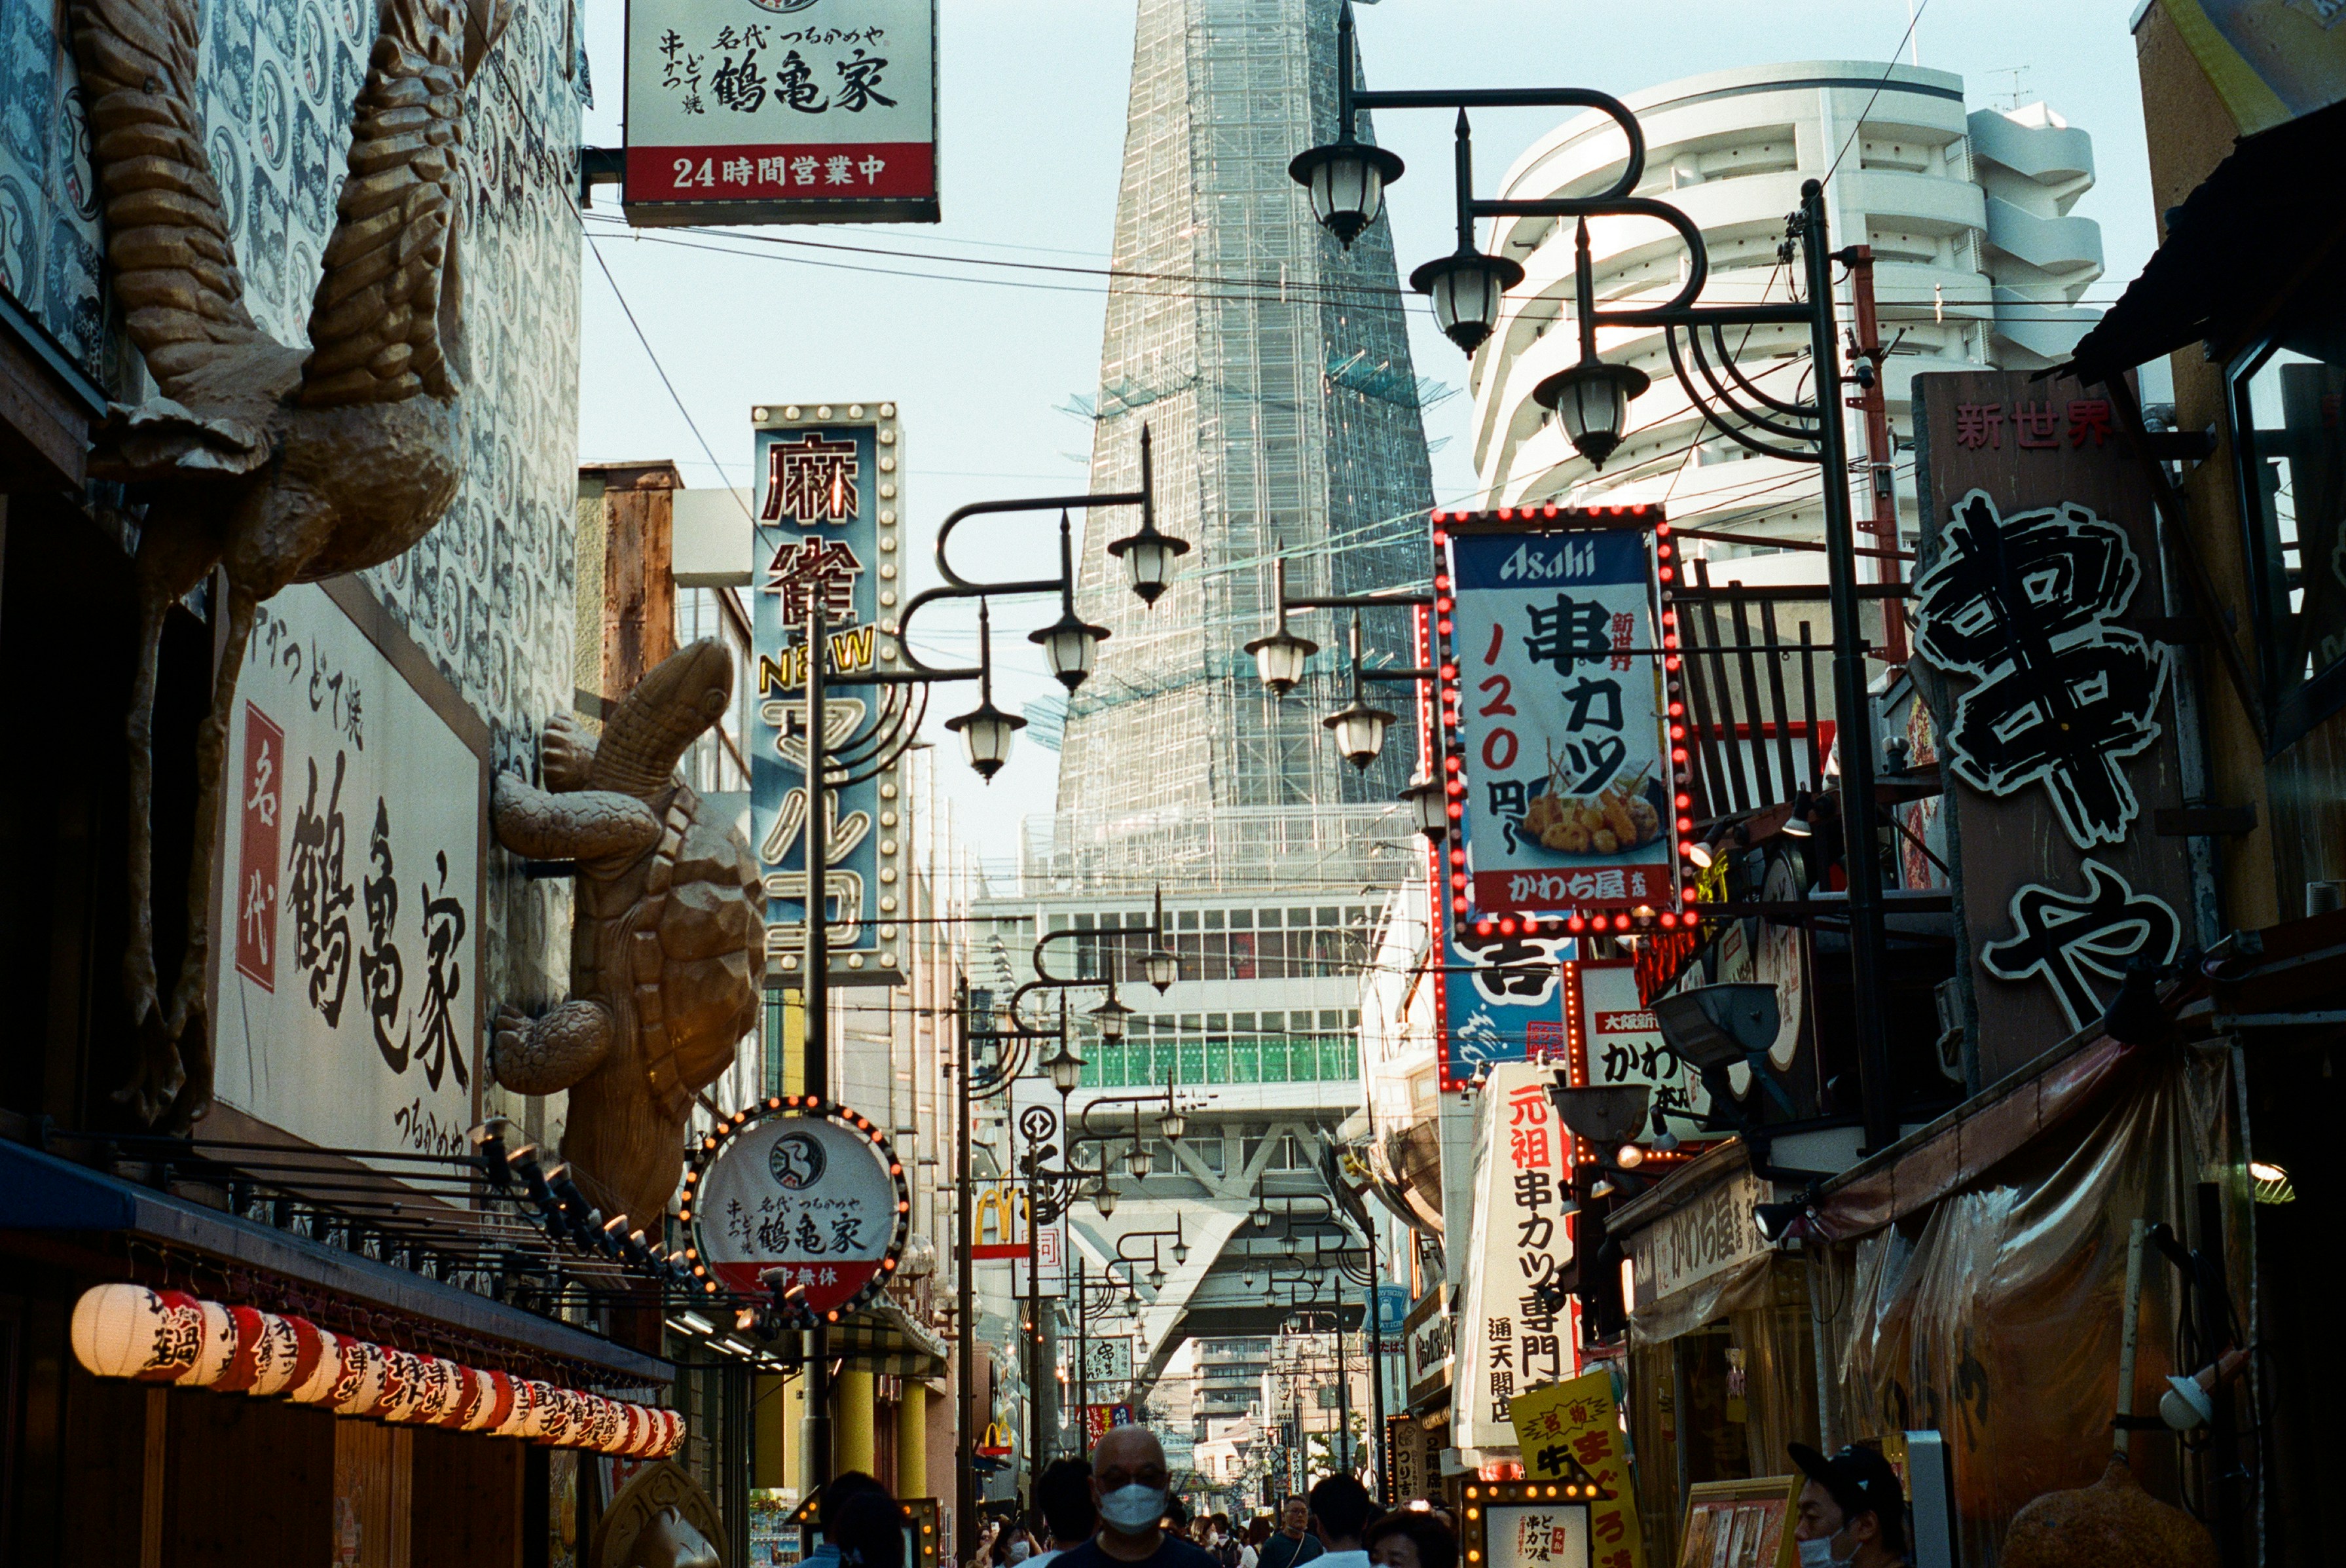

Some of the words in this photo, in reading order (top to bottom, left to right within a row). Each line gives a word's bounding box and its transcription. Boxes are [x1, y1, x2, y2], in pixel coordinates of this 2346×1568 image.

[659, 29, 683, 90] 串かつ
[711, 24, 771, 50] 名代
[780, 26, 884, 47] つるかめや
[682, 54, 705, 115] どて焼
[710, 48, 898, 114] 鶴亀家
[673, 155, 885, 187] 24時間営業中
[1956, 399, 2114, 450] 新世界
[758, 432, 864, 630] 麻雀
[1500, 540, 1596, 580] Asahi
[1611, 612, 1634, 672] 新世界
[1524, 593, 1626, 795] 串カツ
[246, 740, 278, 966] 名代
[1508, 869, 1626, 902] かわち屋
[287, 750, 469, 1095] 鶴亀家
[757, 1212, 867, 1254] 鶴亀家
[1509, 1084, 1561, 1395] 元祖串カツ専門
[1489, 1317, 1513, 1423] 通天閣店
[1398, 1450, 1412, 1496] つり吉
[1537, 1444, 1573, 1481] 牛
[1525, 1514, 1540, 1559] 串カツ
[1537, 1514, 1554, 1562] どて煮
